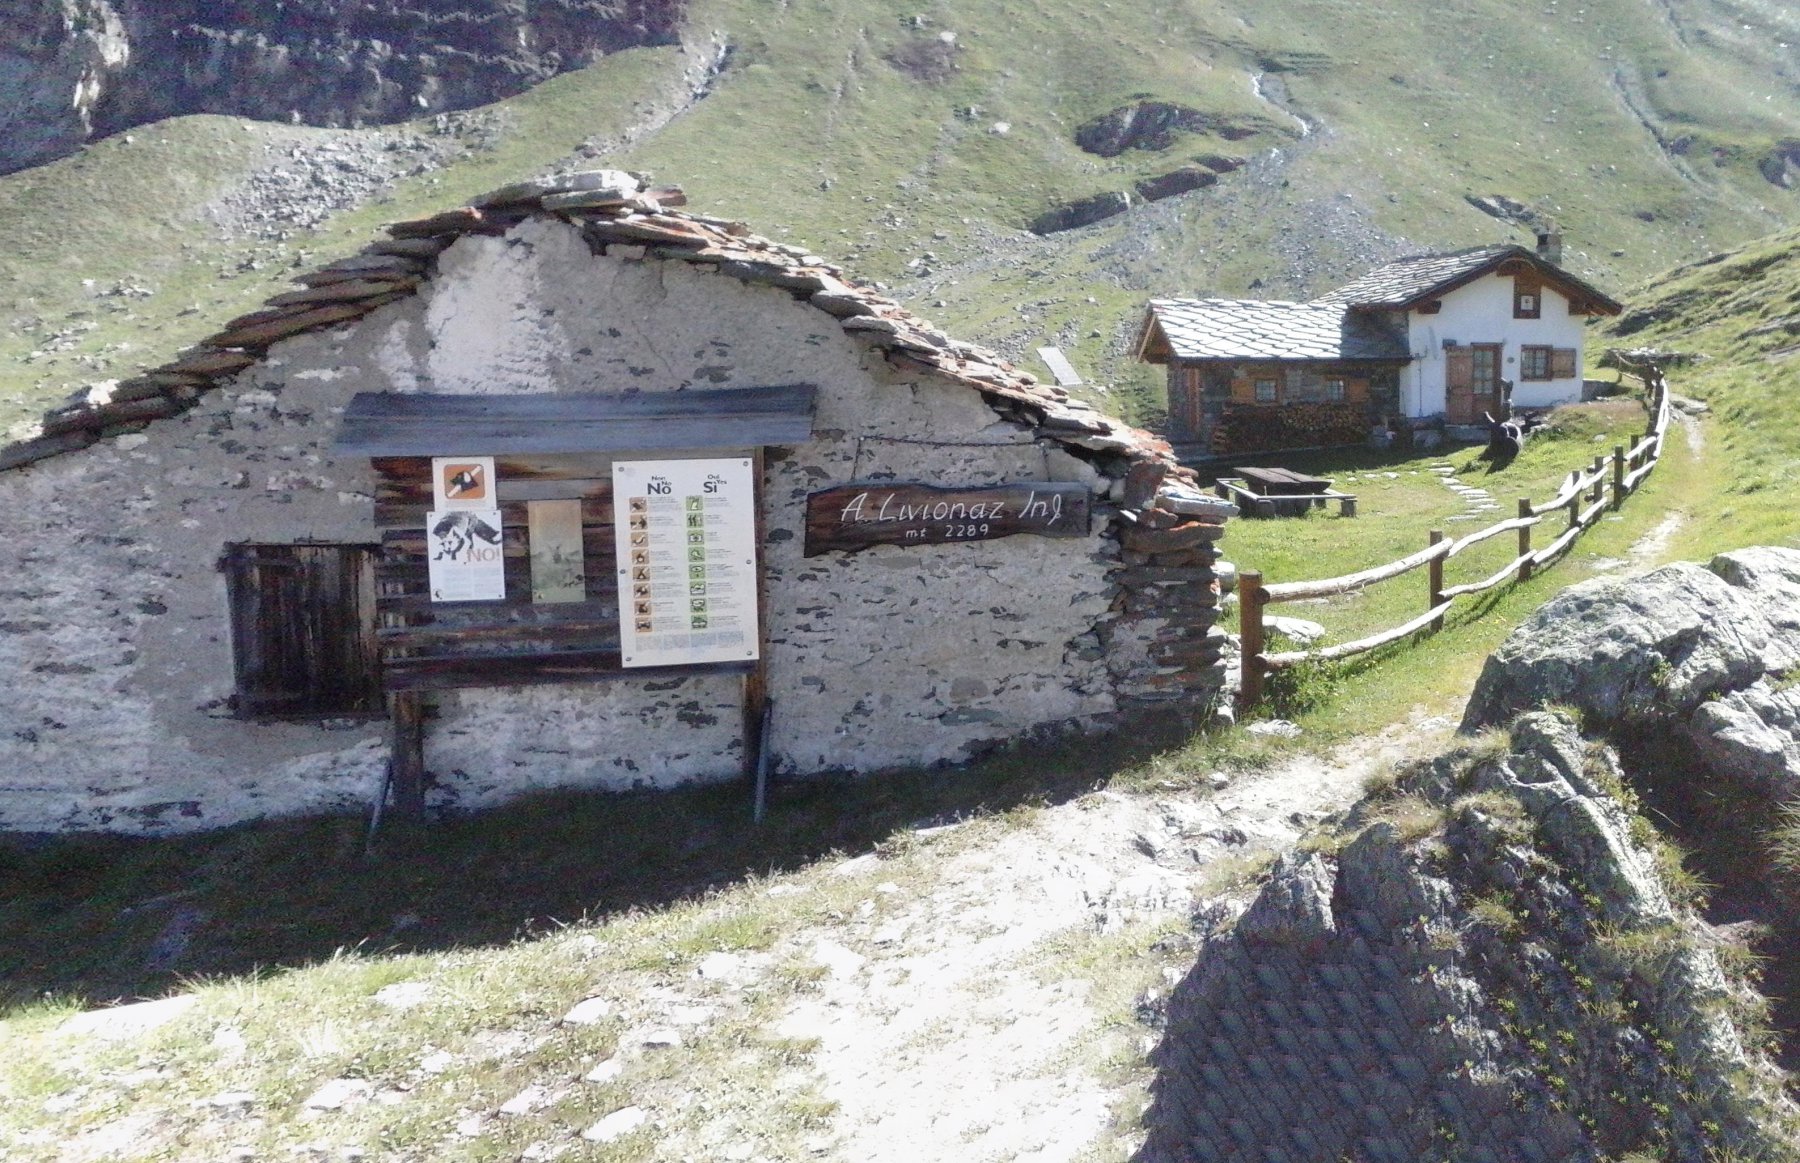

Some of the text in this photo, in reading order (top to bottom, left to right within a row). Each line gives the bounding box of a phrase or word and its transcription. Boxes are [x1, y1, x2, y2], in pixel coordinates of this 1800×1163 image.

[647, 482, 672, 495] No
[840, 492, 868, 522] A
[879, 492, 1005, 521] Livionaz
[905, 523, 989, 539] mt 2289
[466, 548, 501, 562] NO!
